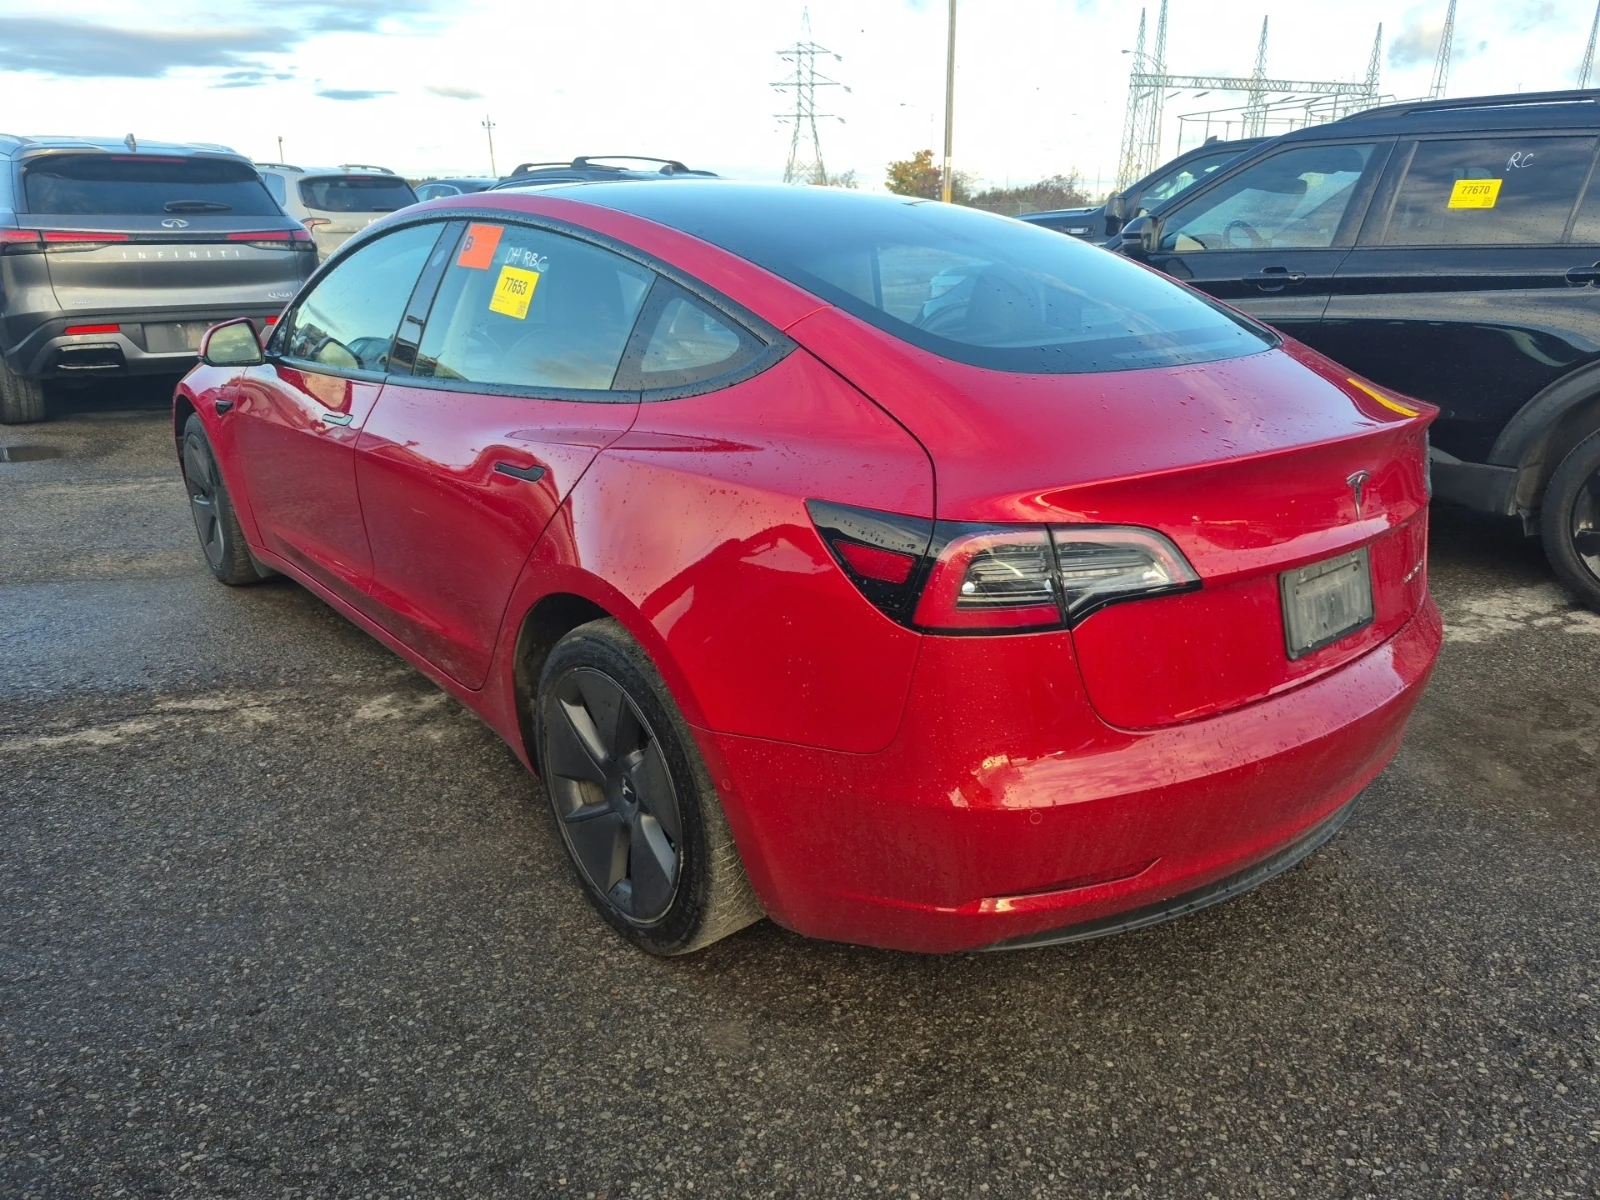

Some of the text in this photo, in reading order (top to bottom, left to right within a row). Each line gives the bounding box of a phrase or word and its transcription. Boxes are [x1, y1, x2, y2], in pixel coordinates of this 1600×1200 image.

[1506, 151, 1534, 172] RC
[1461, 185, 1491, 195] 77670
[122, 250, 240, 259] INFINITI
[502, 277, 528, 295] 77653
[268, 291, 293, 299] QX60
